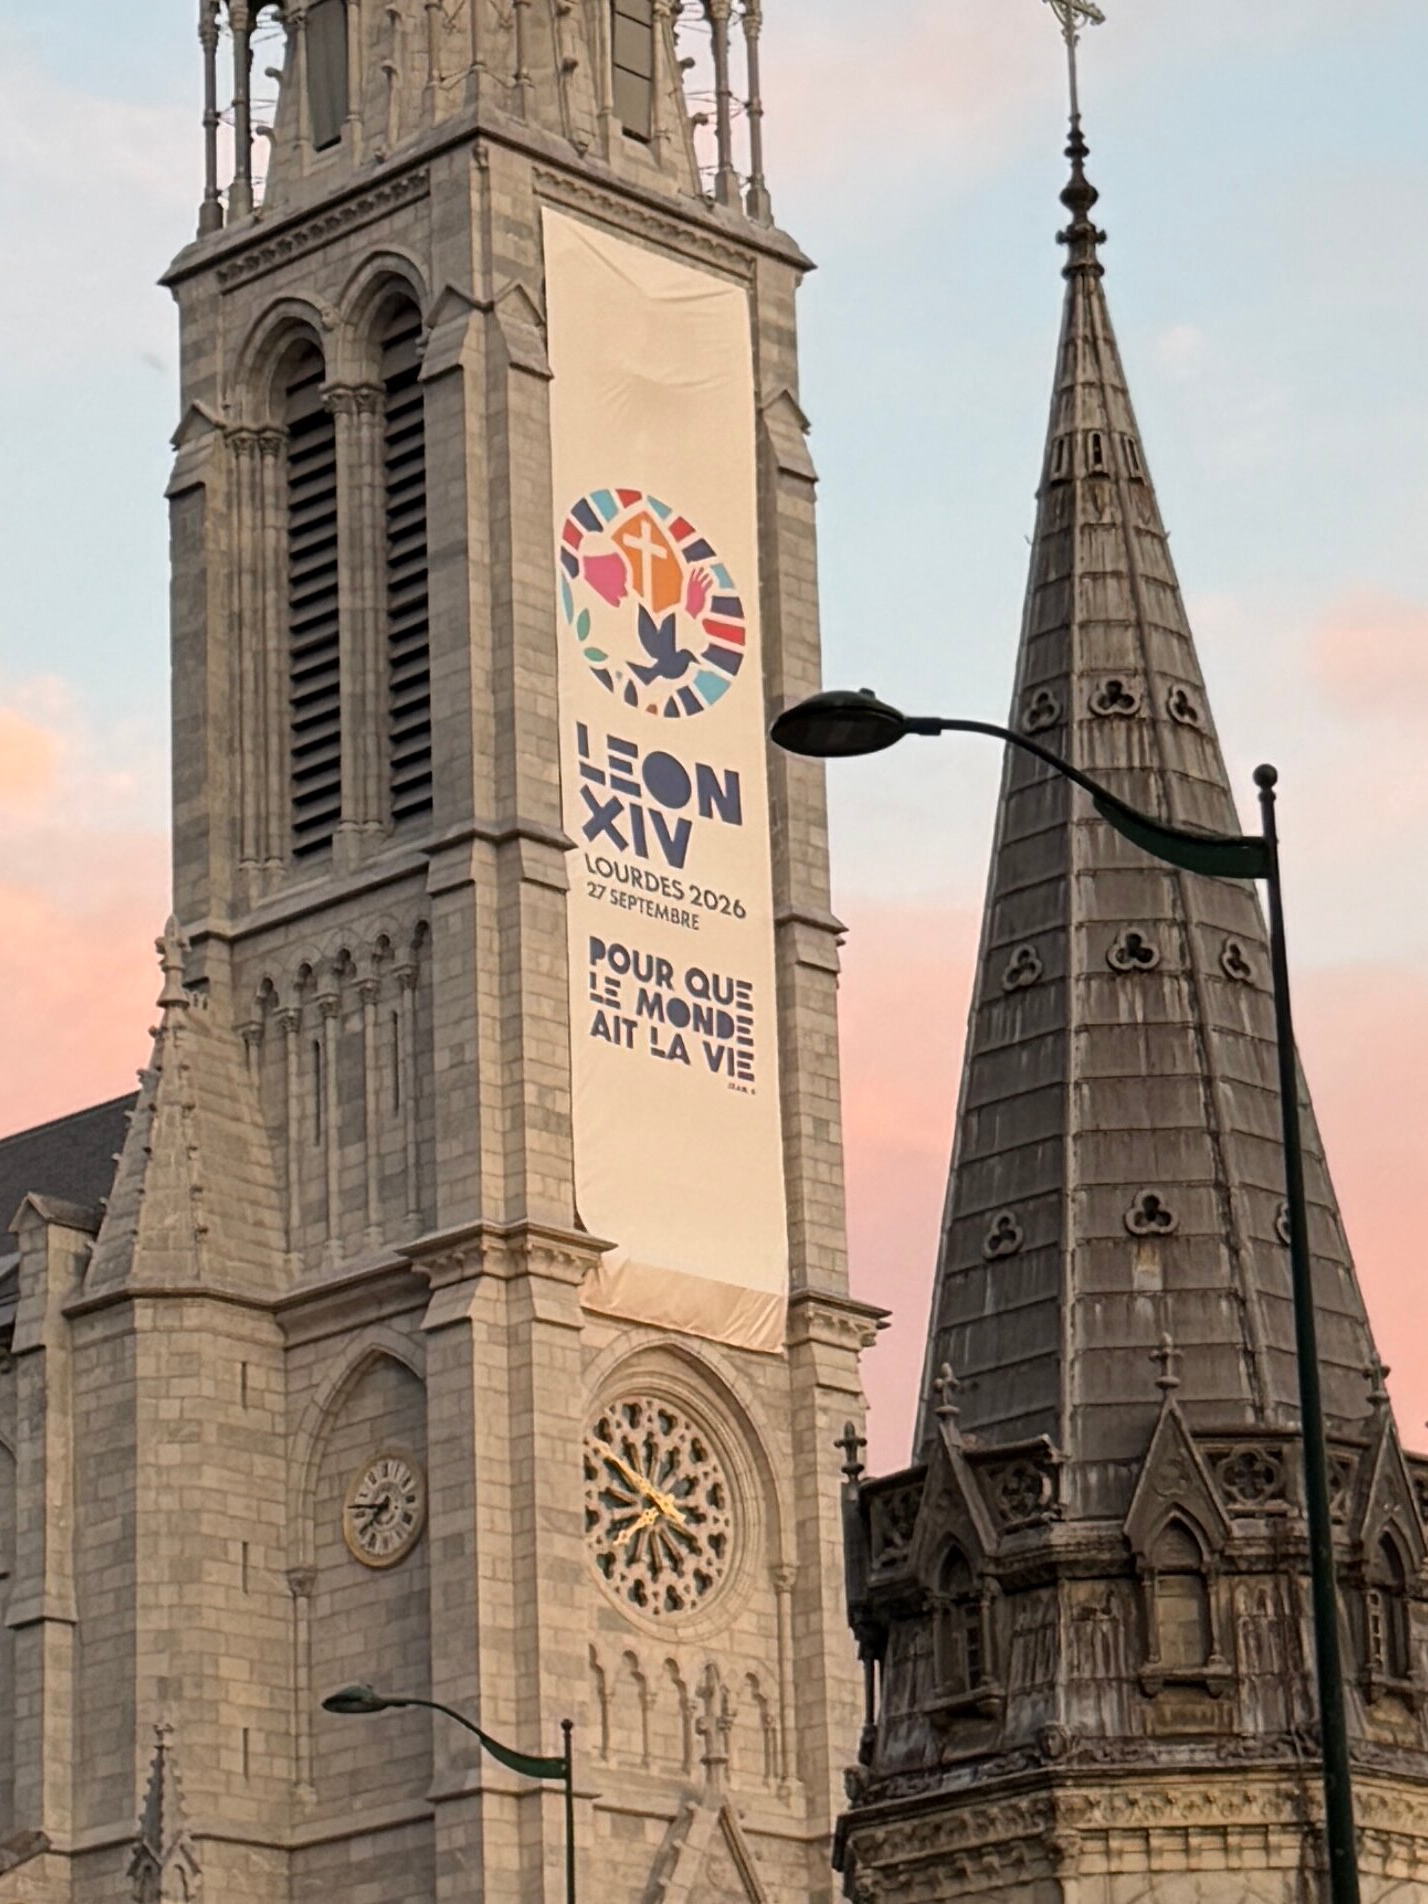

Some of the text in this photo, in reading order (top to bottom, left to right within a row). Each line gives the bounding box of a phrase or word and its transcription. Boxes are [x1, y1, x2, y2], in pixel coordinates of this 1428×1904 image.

[575, 721, 743, 827] LEON
[579, 783, 693, 870] XIV
[584, 852, 747, 920] LOURDES 2026
[586, 881, 700, 931] 27 SEPTEMBRE
[589, 935, 754, 1012] POUR QUE
[589, 971, 754, 1047] LE MONDE
[590, 1009, 755, 1082] AIT LA VIE
